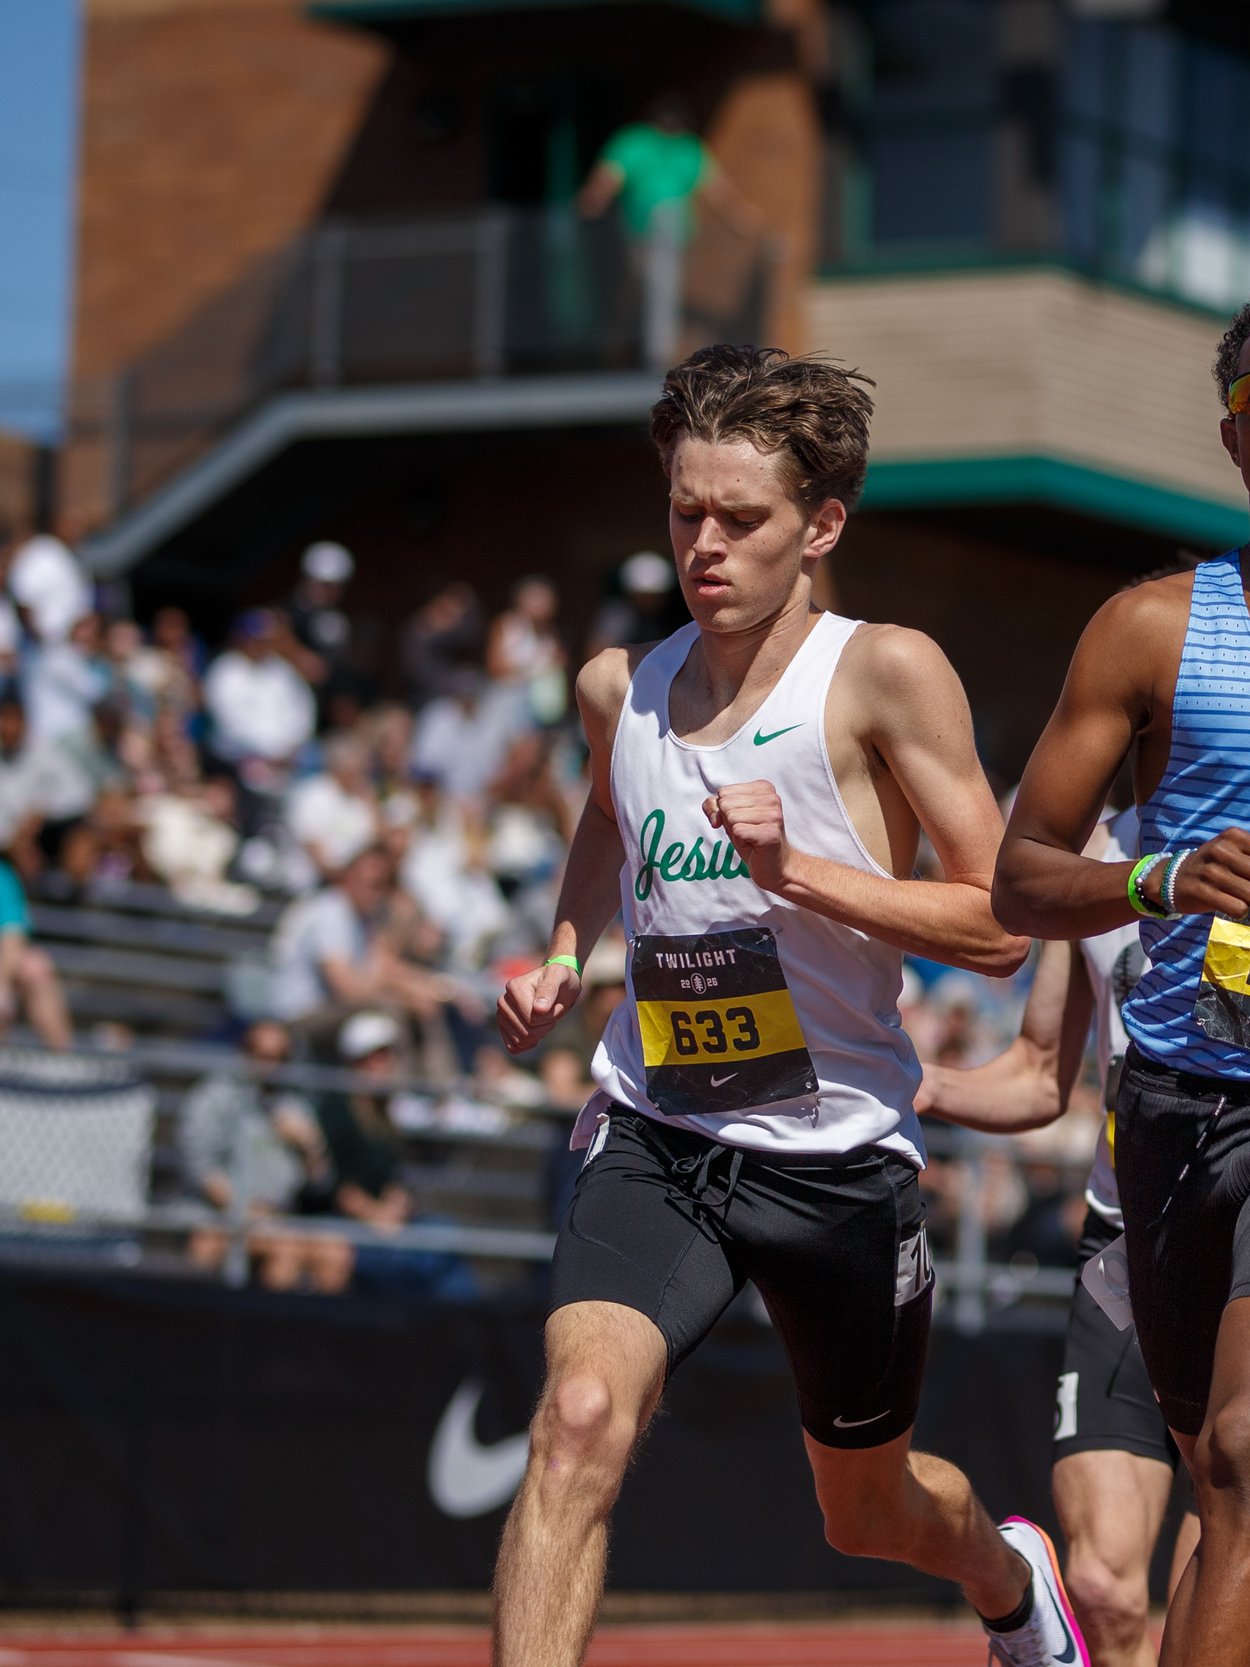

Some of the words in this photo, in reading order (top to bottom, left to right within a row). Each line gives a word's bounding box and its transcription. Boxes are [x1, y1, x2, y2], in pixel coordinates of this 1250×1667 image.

[635, 808, 751, 901] Jesu
[656, 949, 736, 969] TWILIGHT
[670, 1006, 760, 1056] 633
